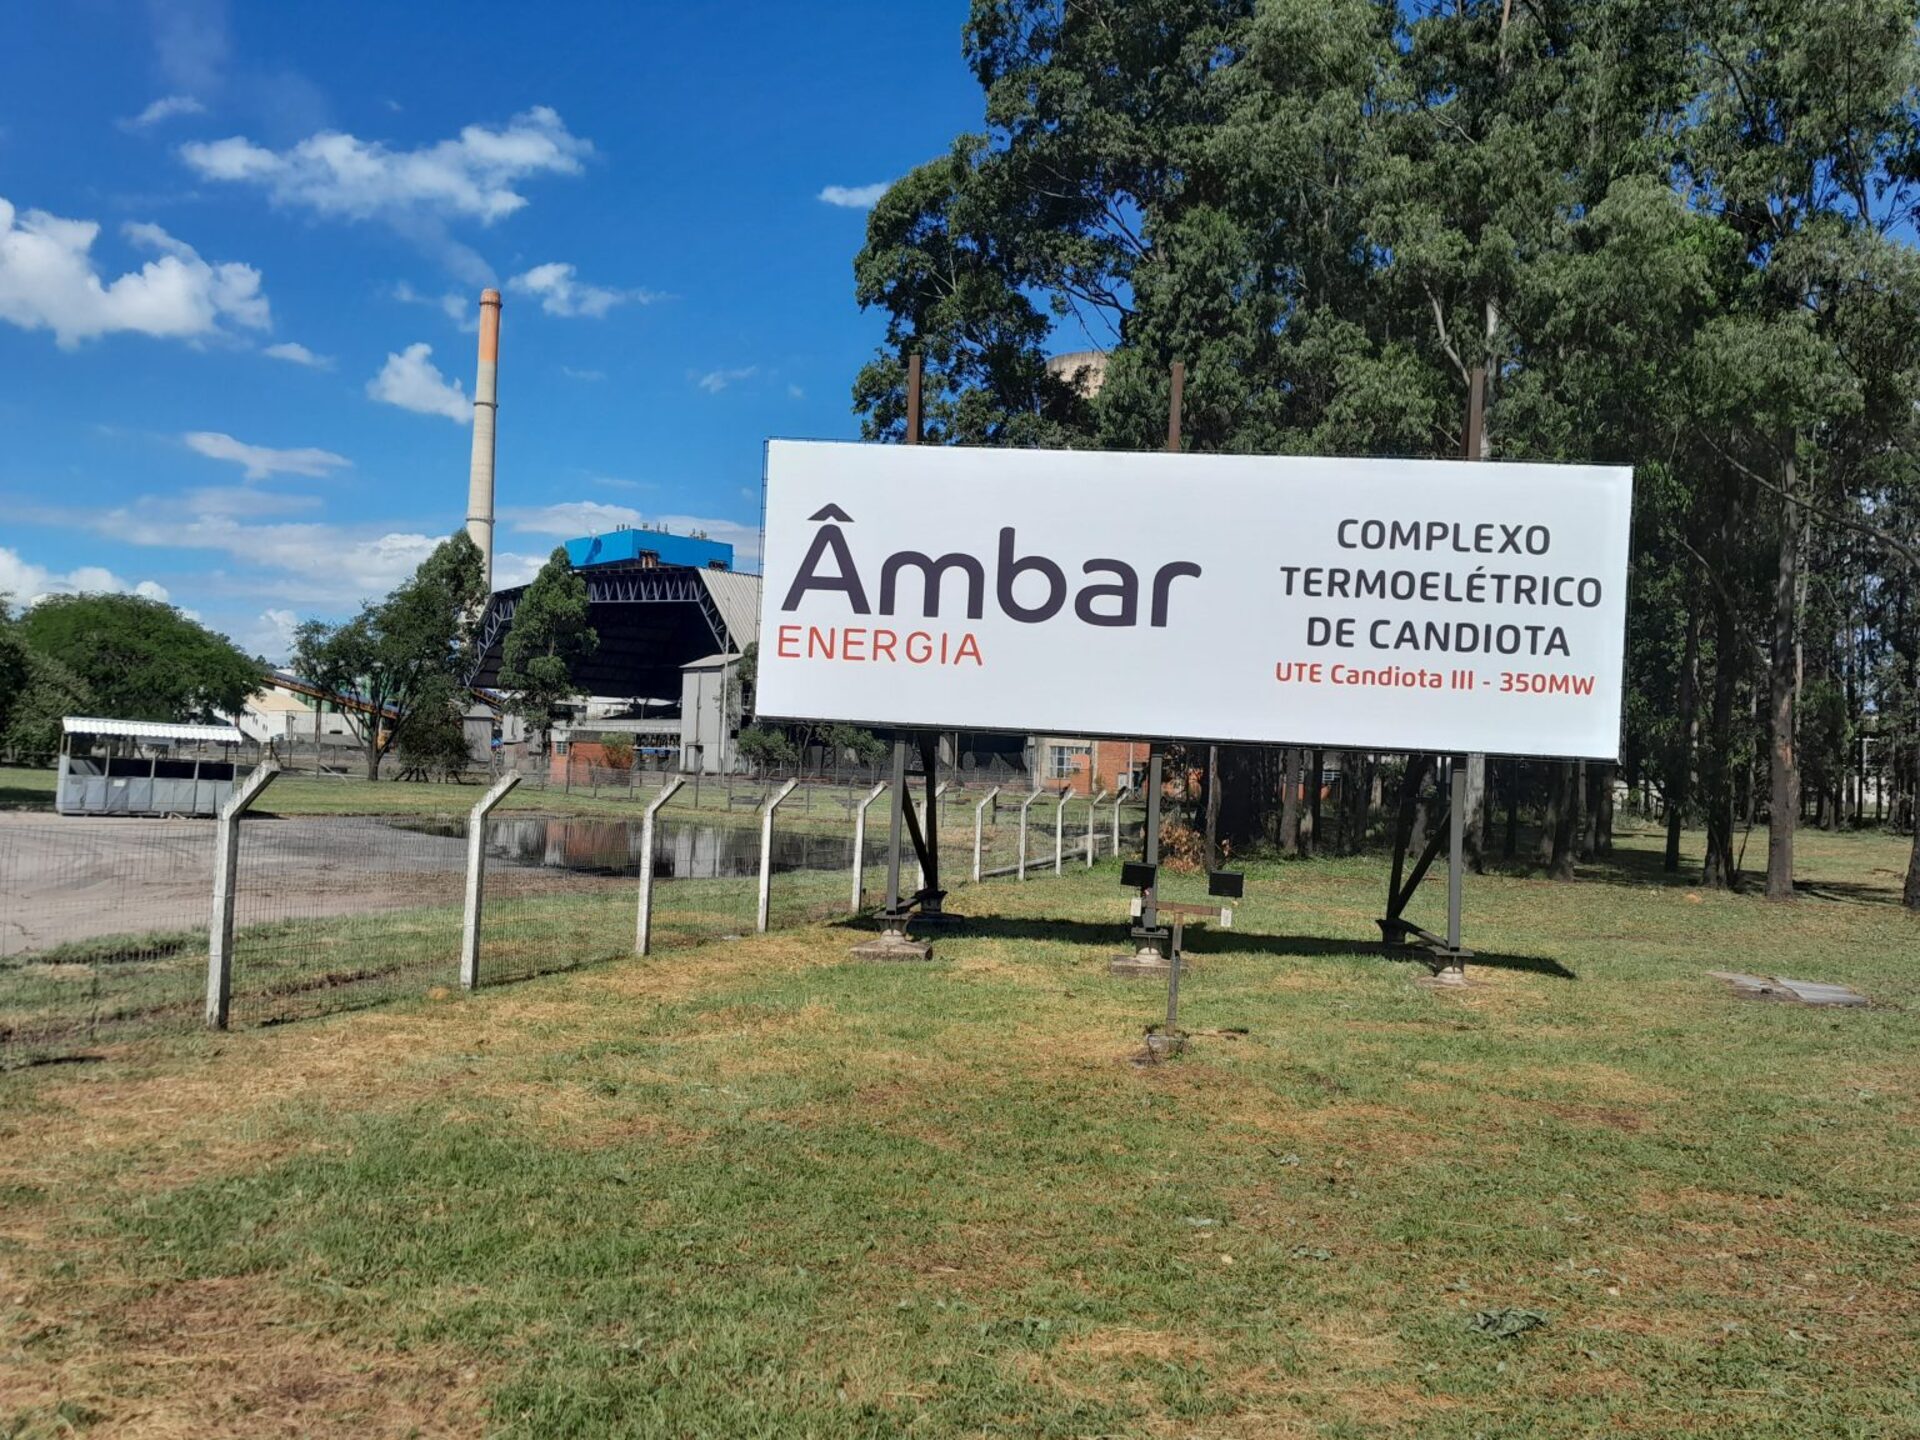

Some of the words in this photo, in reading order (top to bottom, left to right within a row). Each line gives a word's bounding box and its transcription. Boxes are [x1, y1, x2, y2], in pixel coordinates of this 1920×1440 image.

[1337, 518, 1551, 556] COMPLEXO
[780, 502, 1203, 628] Âmbar
[1279, 565, 1602, 608] TERMOELÉTRICO
[777, 624, 983, 667] ENERGIA
[1306, 616, 1356, 648] DE
[1369, 619, 1571, 657] CANDIOTA
[1275, 662, 1323, 683] UTE
[1330, 664, 1443, 689] Candiota
[1451, 669, 1474, 690] III
[1499, 672, 1595, 696] 350MW
